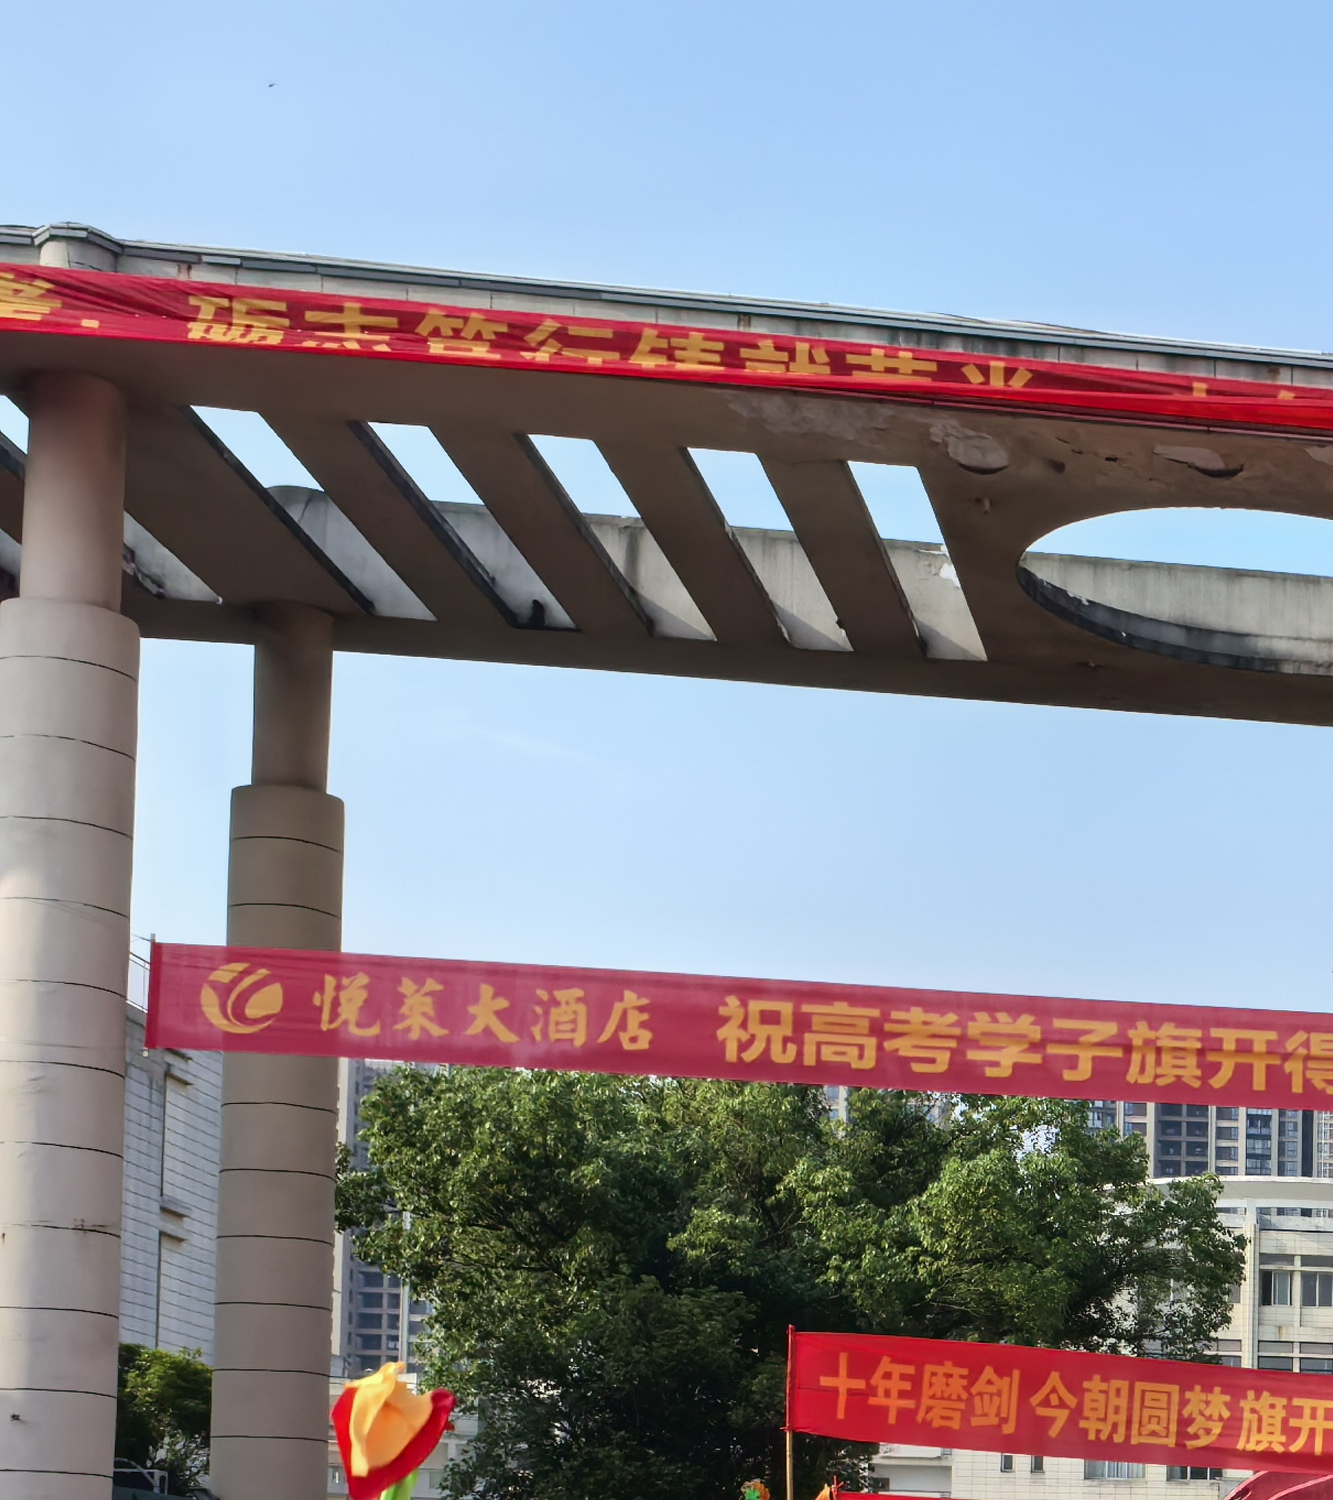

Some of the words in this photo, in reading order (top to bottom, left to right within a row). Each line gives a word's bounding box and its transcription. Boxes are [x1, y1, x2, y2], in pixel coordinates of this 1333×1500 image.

[312, 969, 653, 1054] 悦莱大酒店
